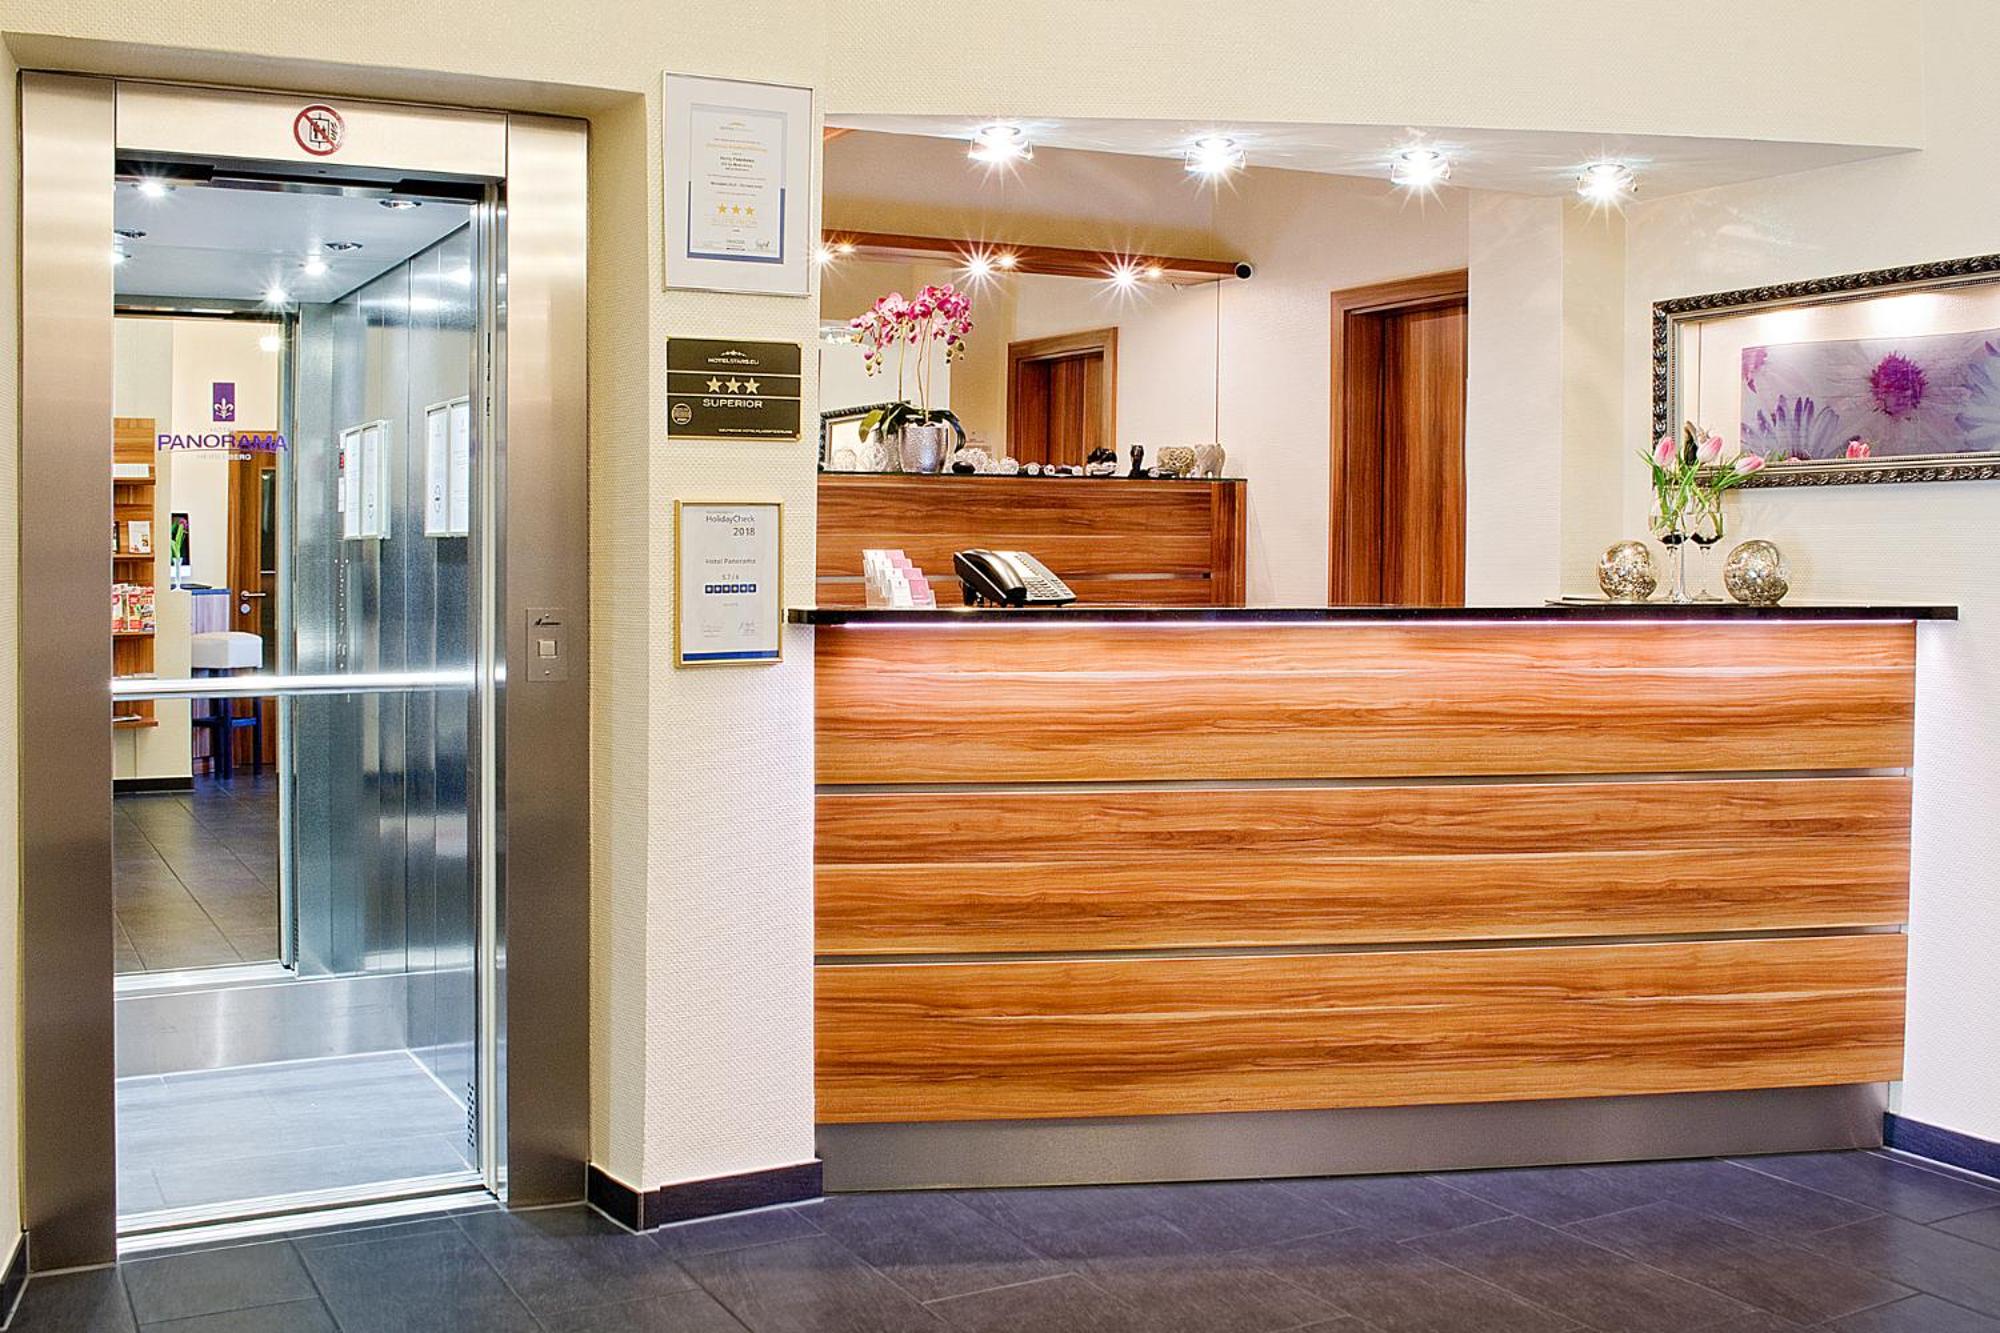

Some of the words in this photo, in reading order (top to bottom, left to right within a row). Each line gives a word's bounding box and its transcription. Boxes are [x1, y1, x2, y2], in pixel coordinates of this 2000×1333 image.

[702, 398, 763, 409] SUPERIOR
[158, 434, 288, 451] PANORAMA
[705, 514, 756, 524] HolidayCheck
[732, 527, 756, 537] 2018
